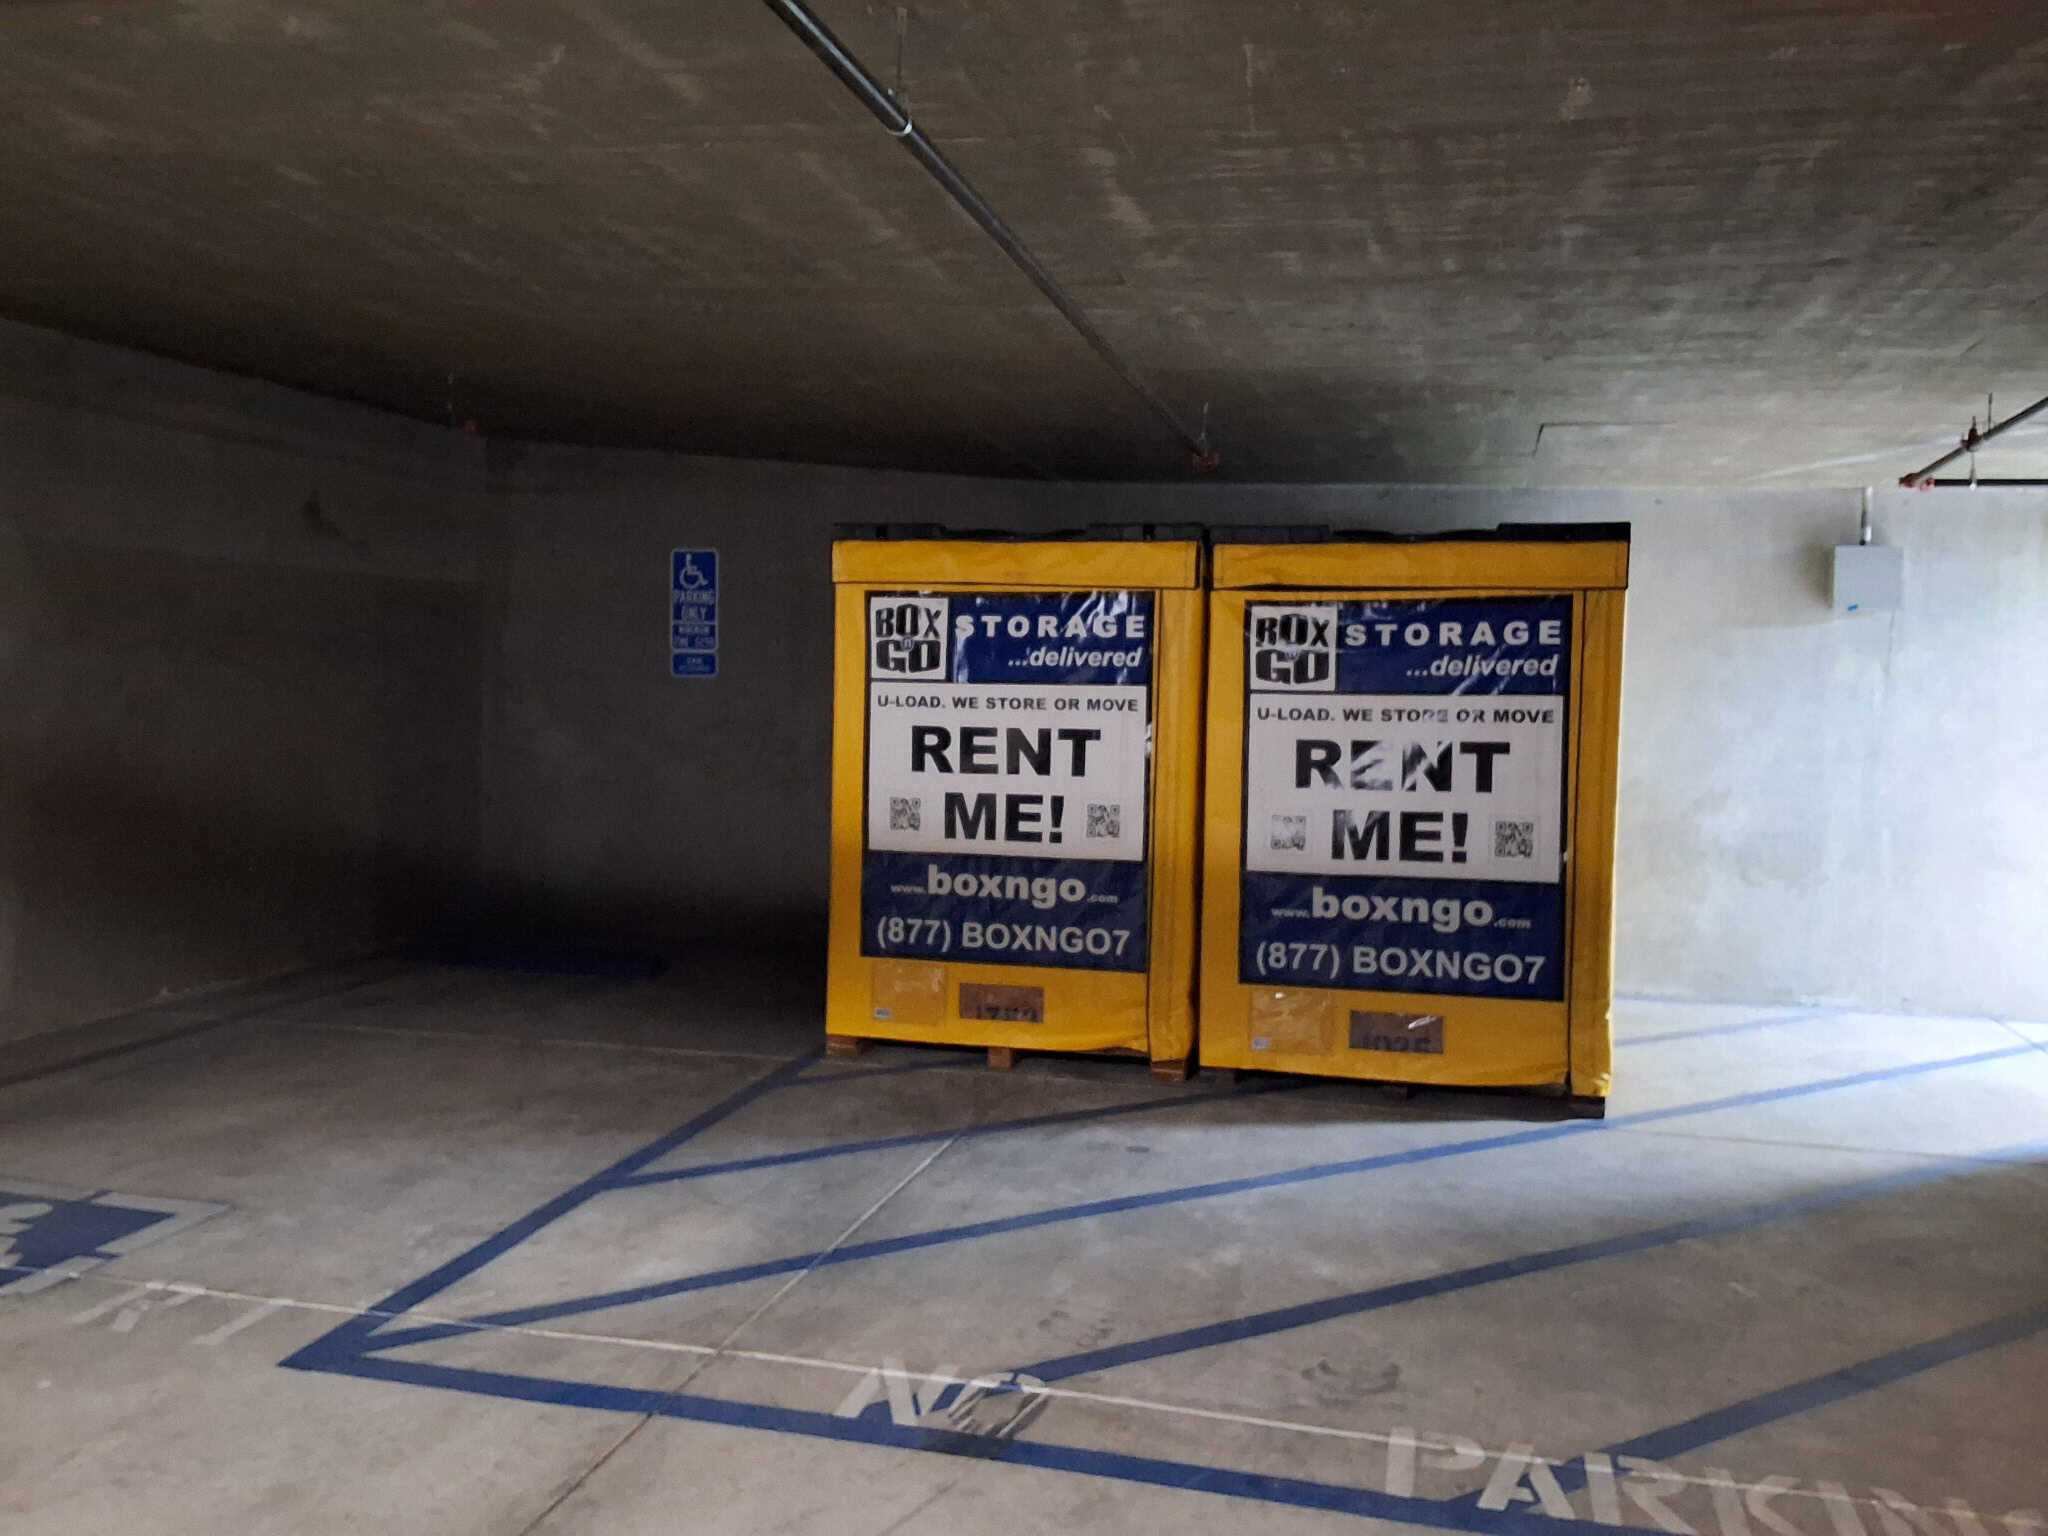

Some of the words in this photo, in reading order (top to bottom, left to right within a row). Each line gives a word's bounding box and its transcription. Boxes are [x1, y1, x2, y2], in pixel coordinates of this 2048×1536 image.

[876, 604, 942, 638] BOX
[954, 614, 1146, 639] STORAGE
[1256, 613, 1330, 647] BOX
[1344, 619, 1562, 647] STORAGE
[877, 640, 941, 673] GO
[1256, 649, 1330, 684] GO
[876, 694, 947, 709] U-LOAD.
[952, 695, 980, 710] WE
[985, 696, 1047, 711] STORE
[1053, 697, 1081, 711] OR
[1086, 698, 1139, 712] MOVE
[1256, 706, 1336, 722] U-LOAD.
[1342, 708, 1374, 722] WE
[1380, 708, 1449, 723] STORE
[1455, 708, 1486, 723] OR
[1493, 708, 1555, 724] MOVE
[911, 725, 1102, 777] RENT
[944, 791, 1066, 844] ME!
[1330, 808, 1469, 864] ME!
[876, 915, 951, 952] (877)
[961, 921, 1131, 955] BOXNGO7
[1255, 941, 1341, 979] (877)
[1352, 945, 1547, 984] BOXNGO7
